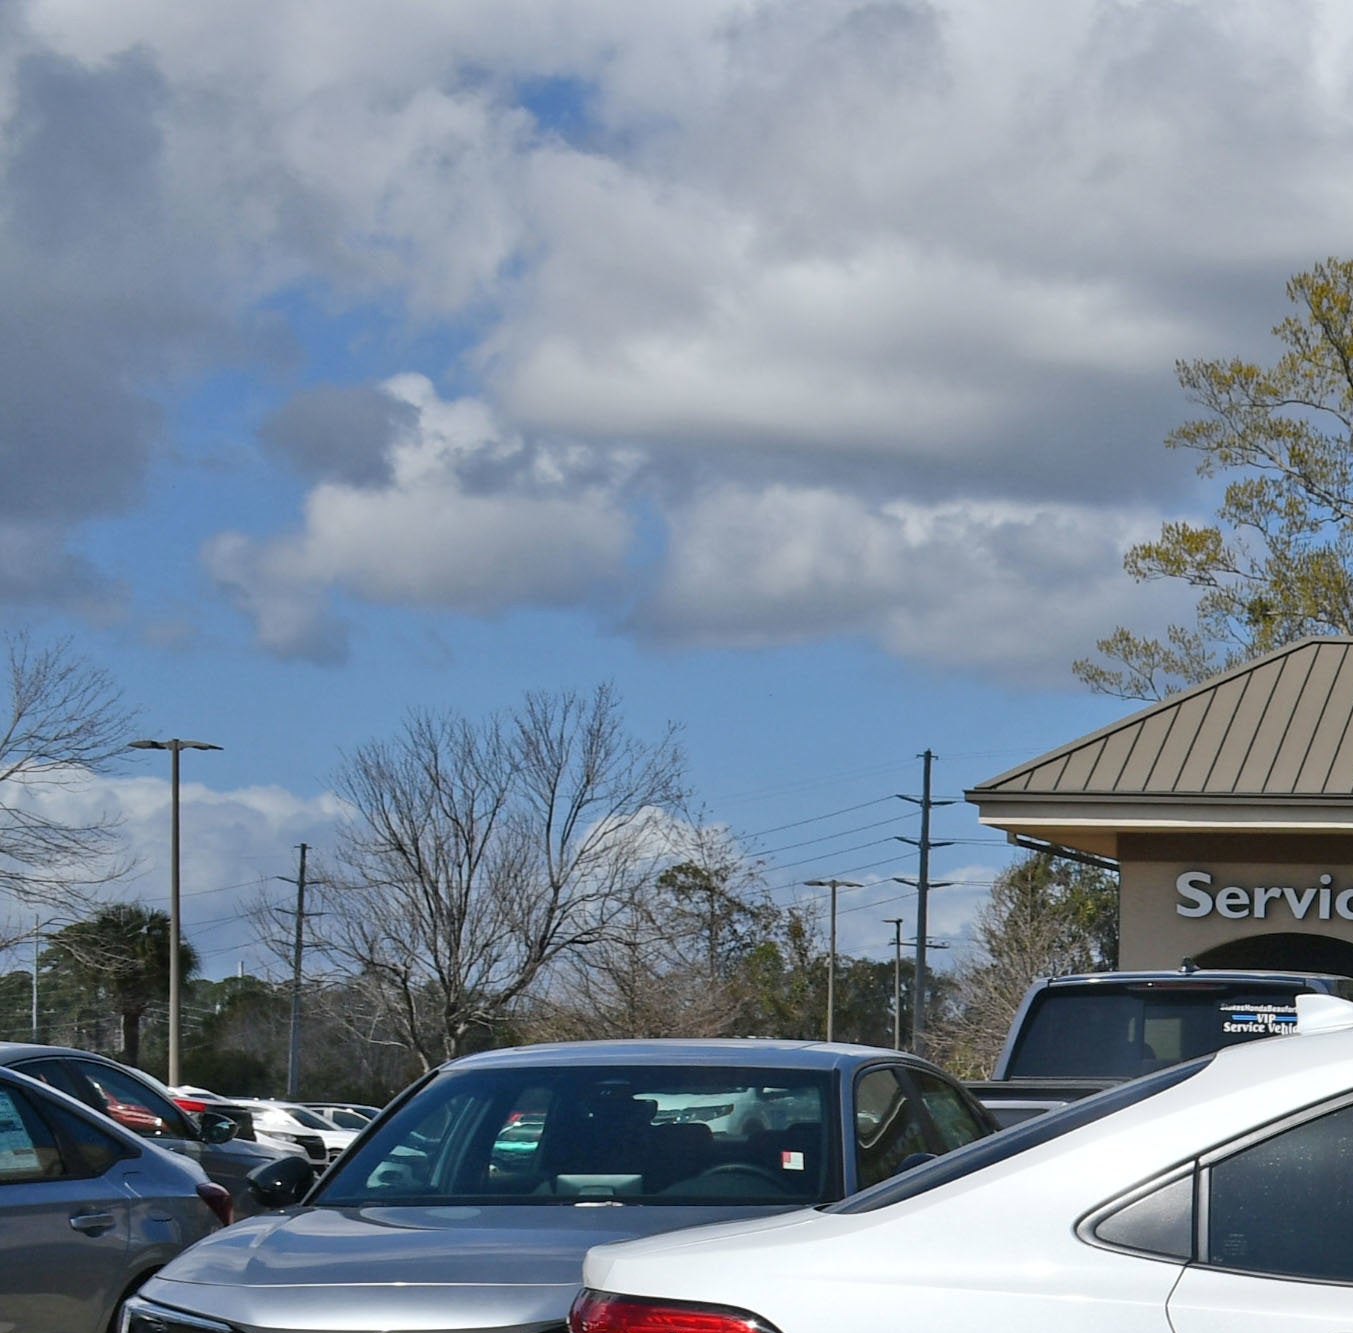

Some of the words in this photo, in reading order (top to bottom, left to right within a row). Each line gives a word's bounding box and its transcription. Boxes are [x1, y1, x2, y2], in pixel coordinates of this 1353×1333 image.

[1256, 1013, 1277, 1024] VIP
[1223, 1021, 1266, 1033] Service
[1267, 1023, 1300, 1035] Vehic
